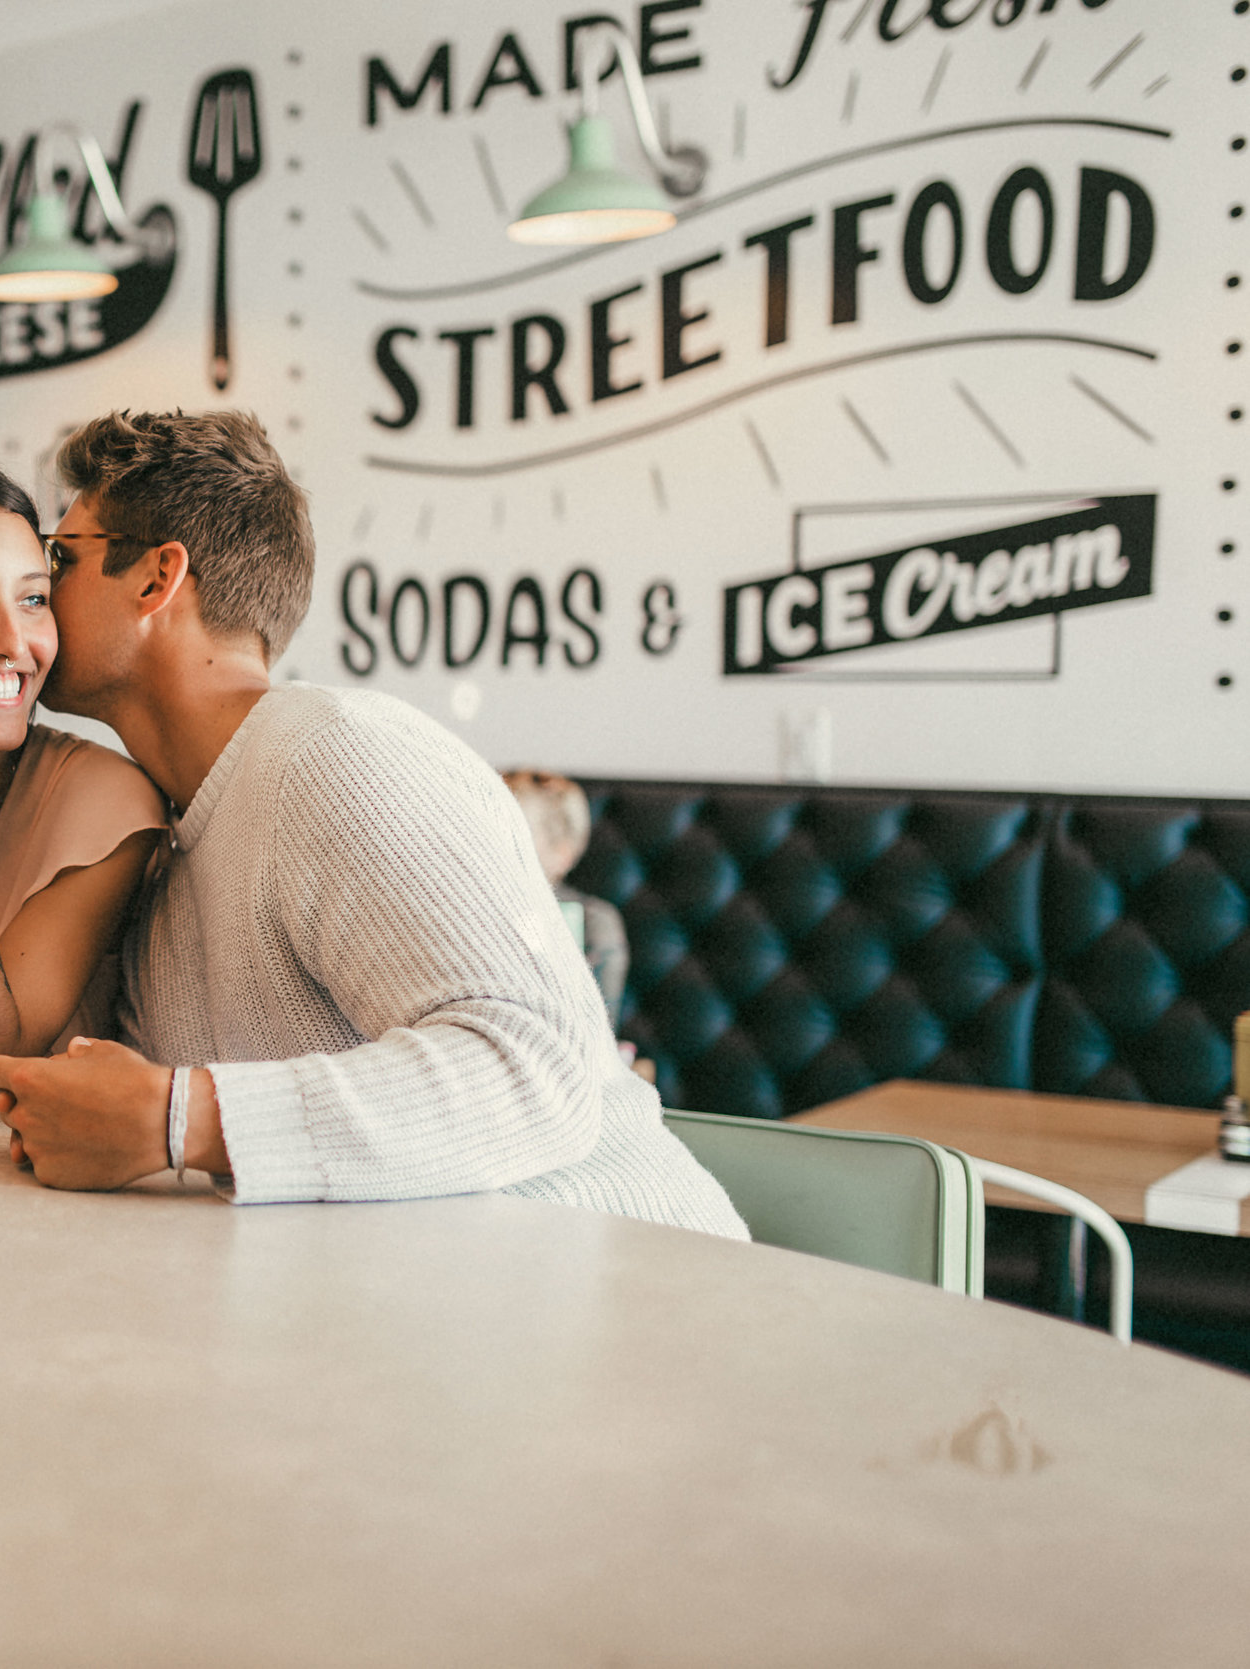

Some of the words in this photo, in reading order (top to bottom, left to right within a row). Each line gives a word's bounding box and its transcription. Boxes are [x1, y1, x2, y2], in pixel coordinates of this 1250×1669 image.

[365, 0, 703, 128] MADE
[764, 0, 1112, 89] fre
[340, 558, 605, 679] SODAS
[640, 580, 683, 658] &
[732, 563, 877, 670] ICE
[882, 515, 1131, 645] Cream
